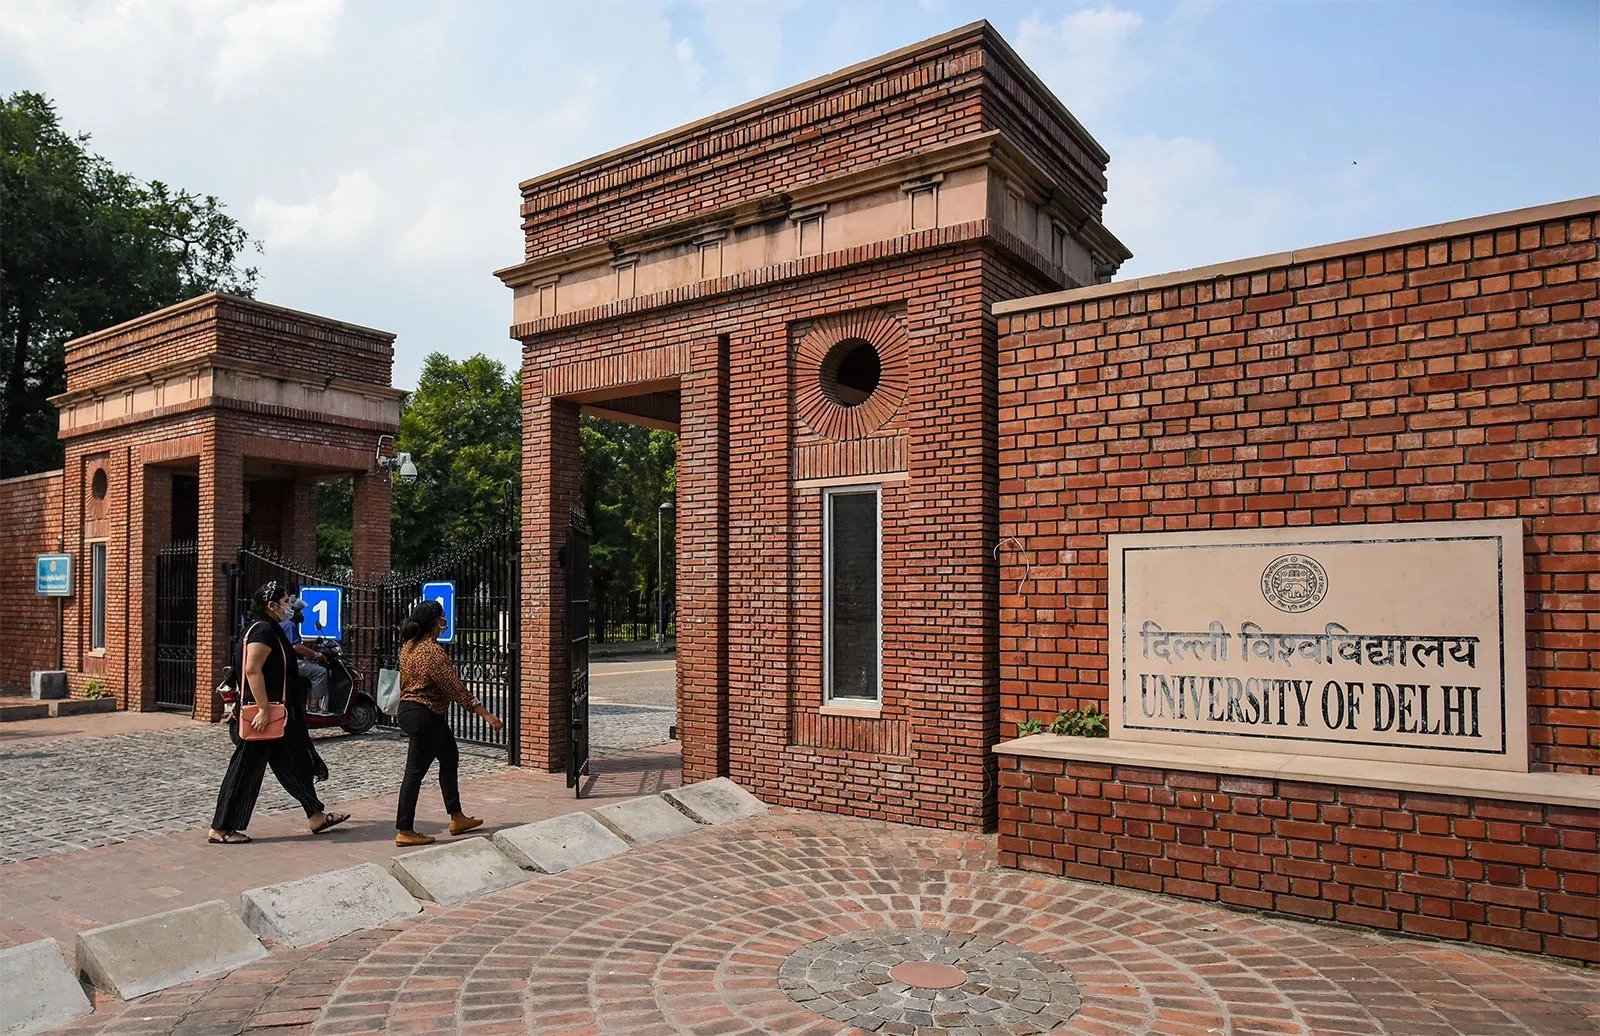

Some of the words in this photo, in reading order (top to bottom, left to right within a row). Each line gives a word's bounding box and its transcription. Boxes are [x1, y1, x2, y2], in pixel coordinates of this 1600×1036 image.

[312, 600, 328, 627] 1
[1139, 620, 1231, 664] दिल्ली
[1237, 621, 1481, 669] विश्वविद्यालय
[1139, 673, 1313, 728] UNIVERSITY
[1321, 679, 1365, 730] OF
[1372, 682, 1483, 738] DELHI
